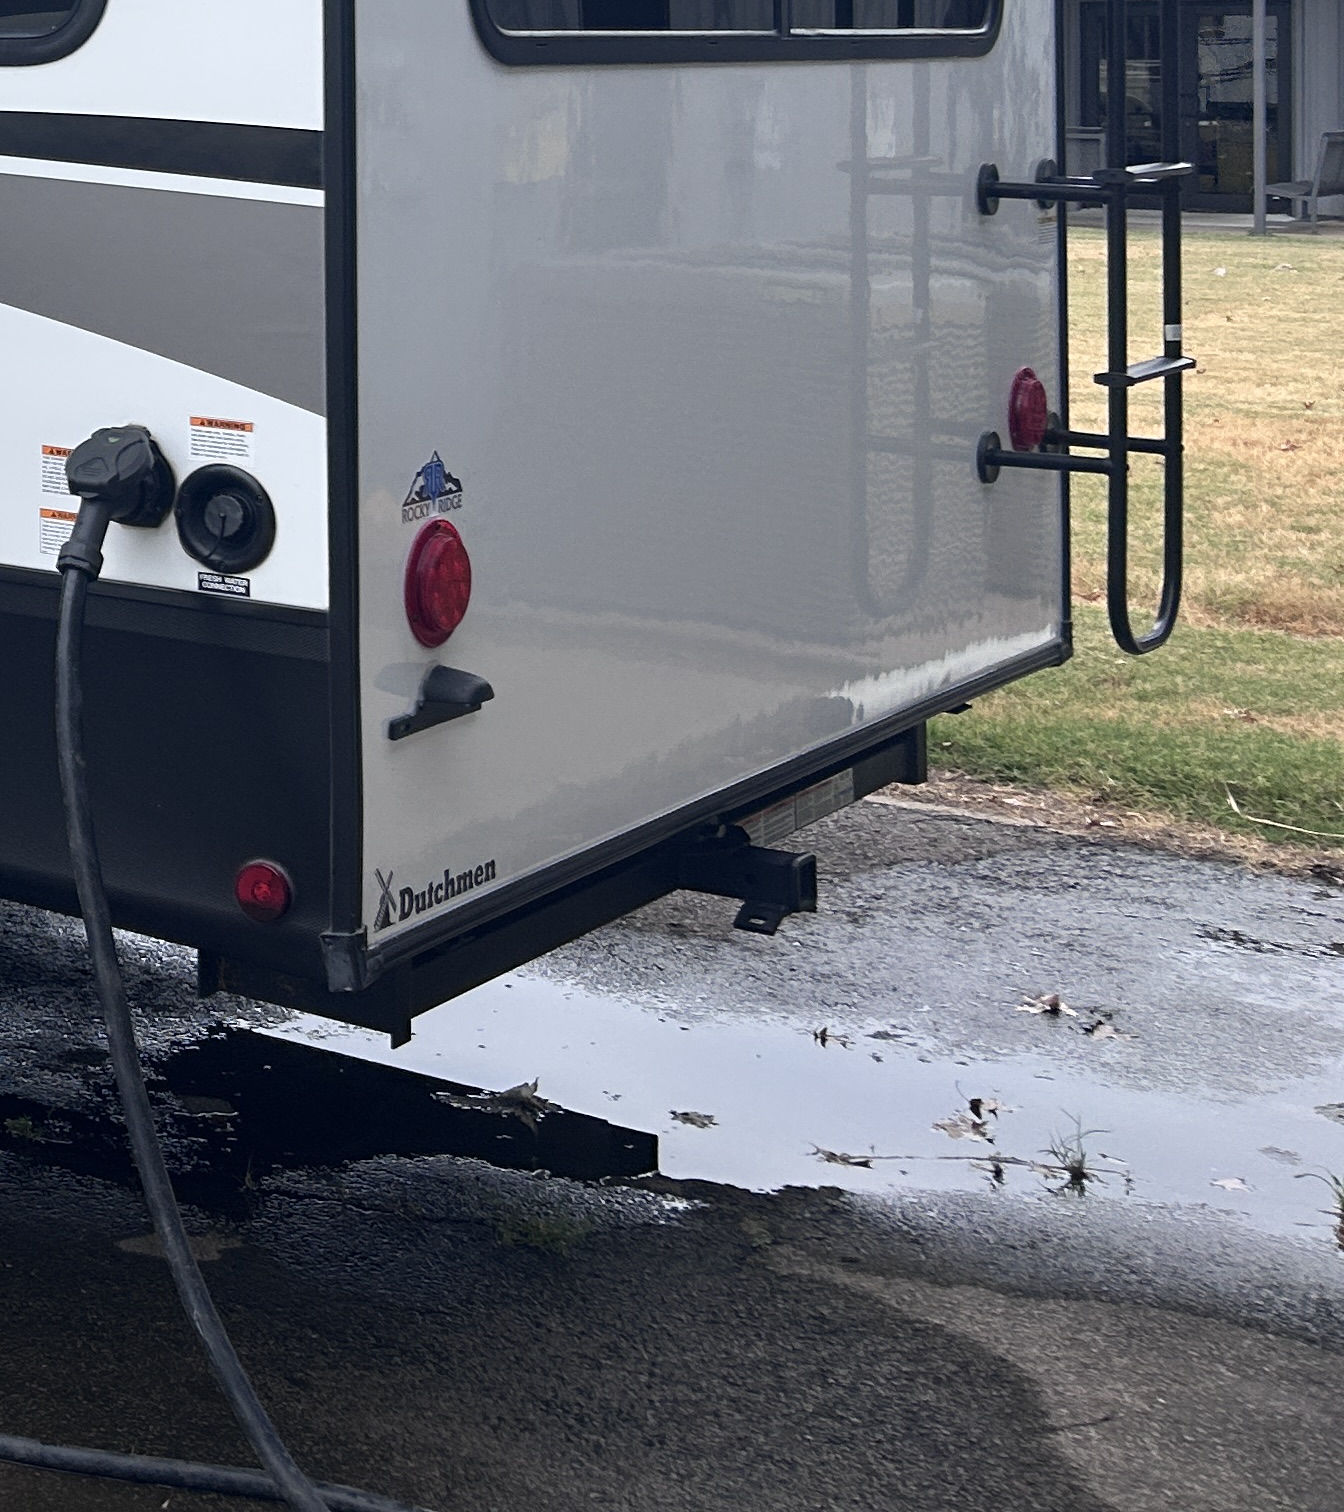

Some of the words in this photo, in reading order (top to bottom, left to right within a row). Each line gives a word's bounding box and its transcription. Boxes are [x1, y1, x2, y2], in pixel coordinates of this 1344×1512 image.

[401, 501, 430, 524] ROCKY
[438, 493, 463, 514] RIDGE
[398, 858, 497, 923] Dutchmen
